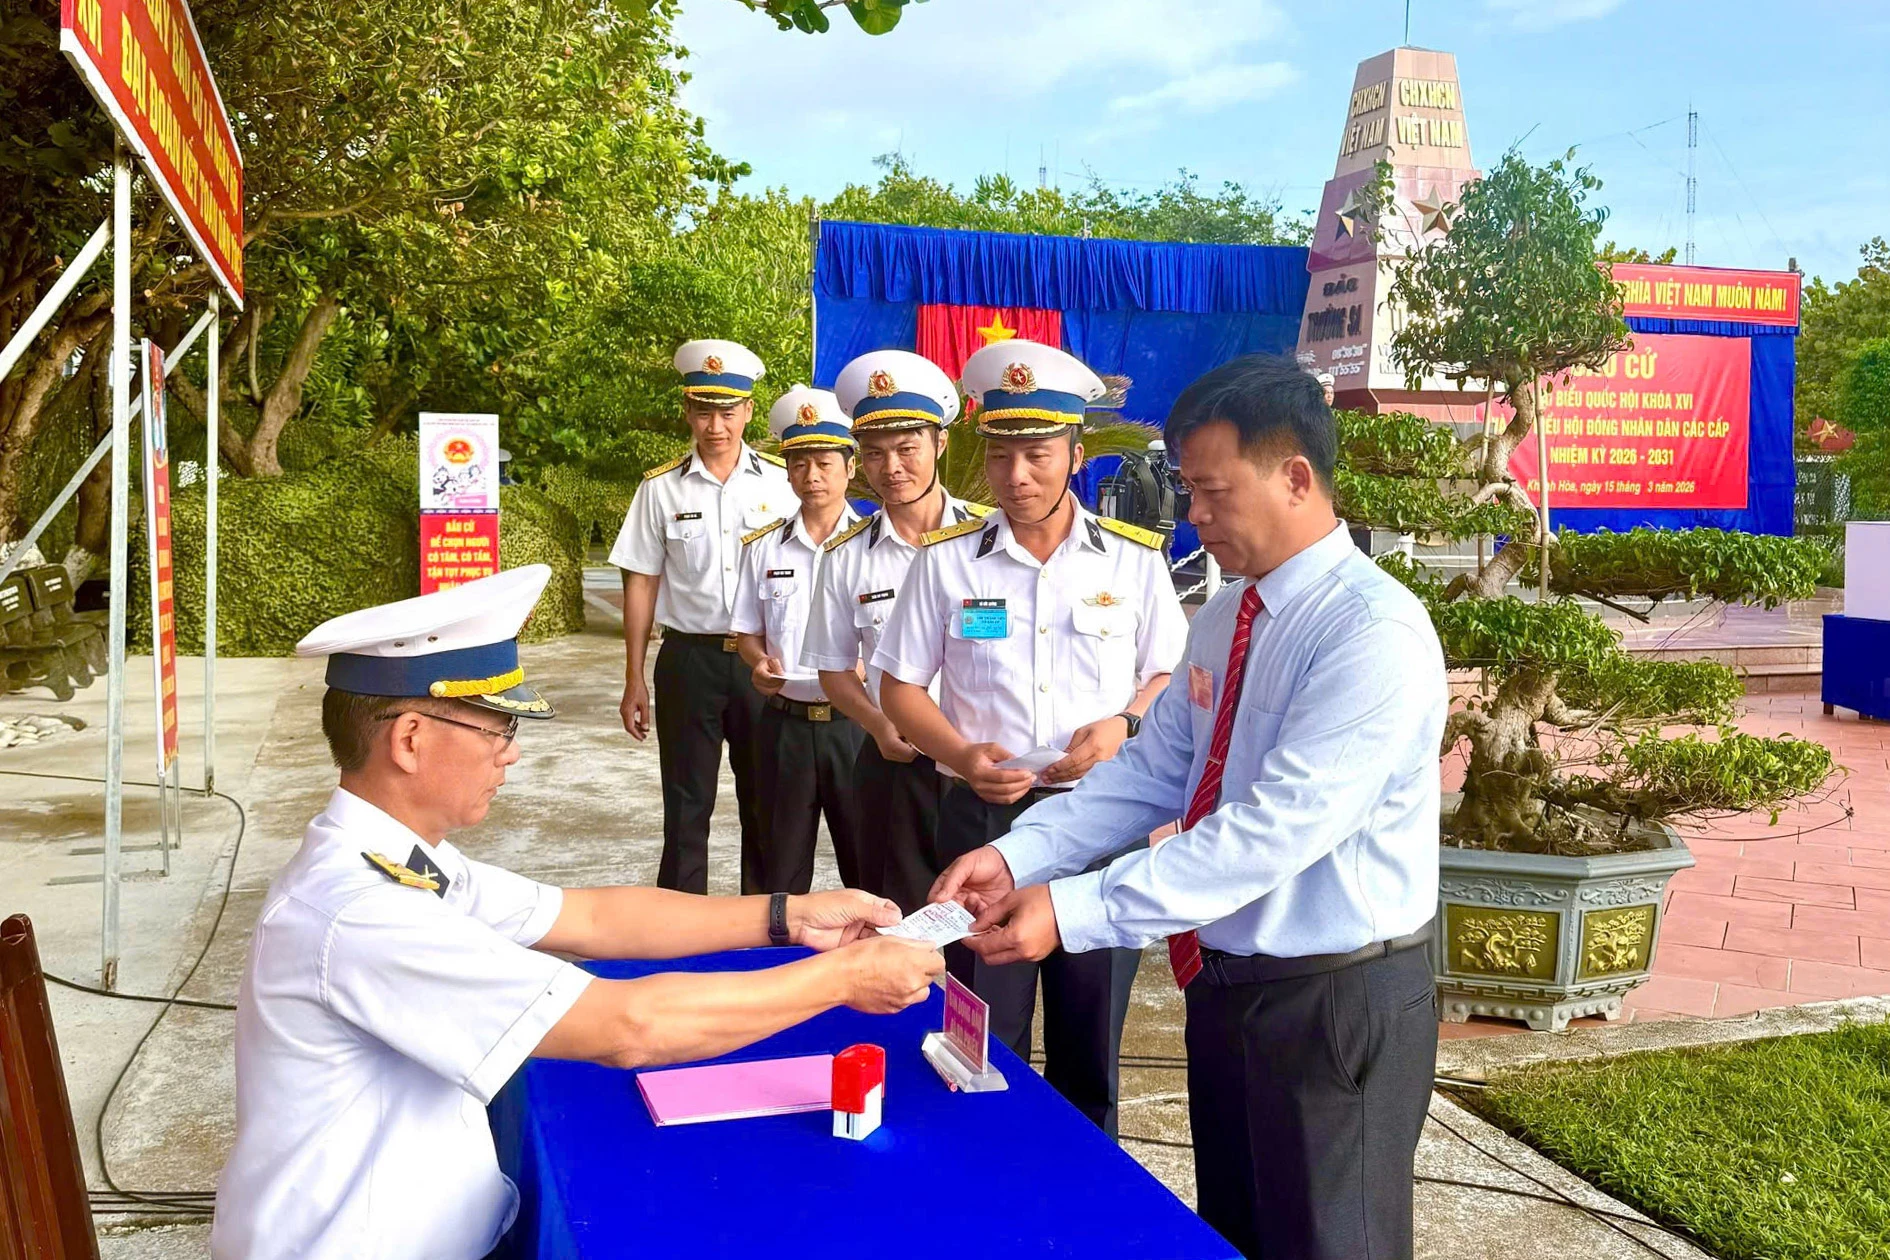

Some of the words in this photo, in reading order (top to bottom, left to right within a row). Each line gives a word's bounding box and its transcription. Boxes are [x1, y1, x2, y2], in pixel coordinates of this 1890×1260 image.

[171, 15, 191, 104] BẦU
[191, 69, 203, 131] CỬ
[203, 97, 214, 157] LÀ
[1399, 78, 1456, 110] CHXHCN
[121, 10, 147, 117] ĐẠI
[149, 67, 181, 176] ĐOÀN
[181, 134, 199, 207] KẾT
[1360, 117, 1386, 150] NAM
[1396, 111, 1427, 150] VIỆT
[1428, 117, 1464, 148] NAM
[1655, 278, 1681, 310] VIỆT
[1684, 282, 1713, 308] NAM
[1716, 282, 1752, 309] MUÔN
[1755, 283, 1787, 311] NĂM!
[1624, 346, 1658, 380] CỬ
[1556, 383, 1582, 408] BIỂU
[1586, 385, 1617, 410] QUỐC
[1620, 388, 1639, 412] HỘI
[1642, 389, 1672, 410] KHÓA
[1675, 393, 1693, 410] XVI
[1564, 415, 1583, 439] HỘI
[1621, 416, 1653, 437] NHÂN
[1656, 417, 1680, 437] DÂN
[1682, 417, 1705, 438] CÁC
[1707, 415, 1730, 438] CẤP
[1550, 443, 1588, 467] NHIỆM
[1591, 444, 1606, 464] KỲ
[1609, 448, 1637, 465] 2026
[1648, 448, 1674, 465] 2031
[1580, 480, 1602, 495] ngày
[1605, 481, 1615, 492] 15
[1616, 480, 1641, 495] tháng
[1647, 481, 1653, 492] 3
[1675, 481, 1695, 493] 2026
